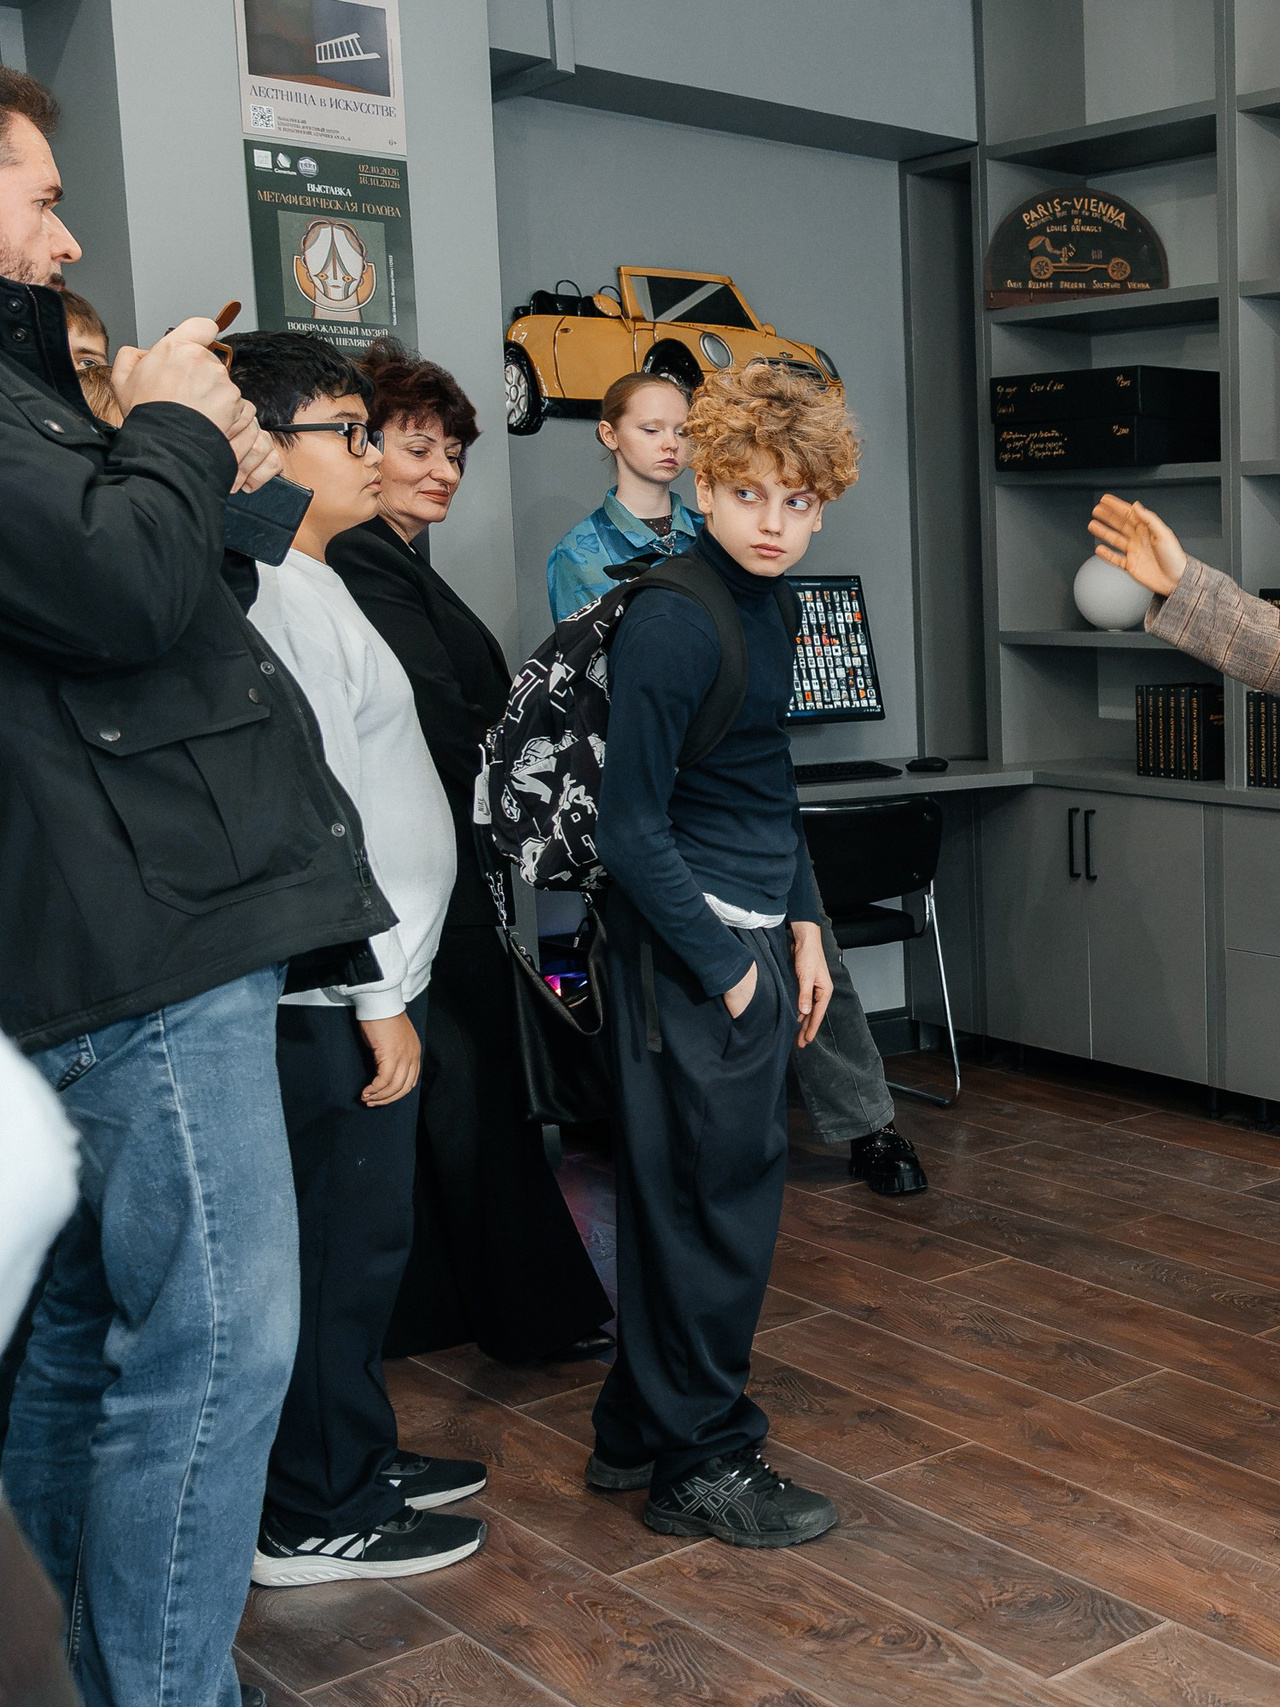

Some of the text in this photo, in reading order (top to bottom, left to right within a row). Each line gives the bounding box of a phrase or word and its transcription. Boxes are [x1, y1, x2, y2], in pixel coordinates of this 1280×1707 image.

[250, 85, 316, 106] ЛЕСТНИЦА
[329, 97, 397, 118] ИСКУССТВЕ
[306, 183, 353, 197] ВЫСТАВКА
[257, 190, 402, 218] МЕТАФИЗИЧЕСКАЯ ГОЛОВА
[287, 321, 359, 336] ВООБРАЖАЕМЫЙ
